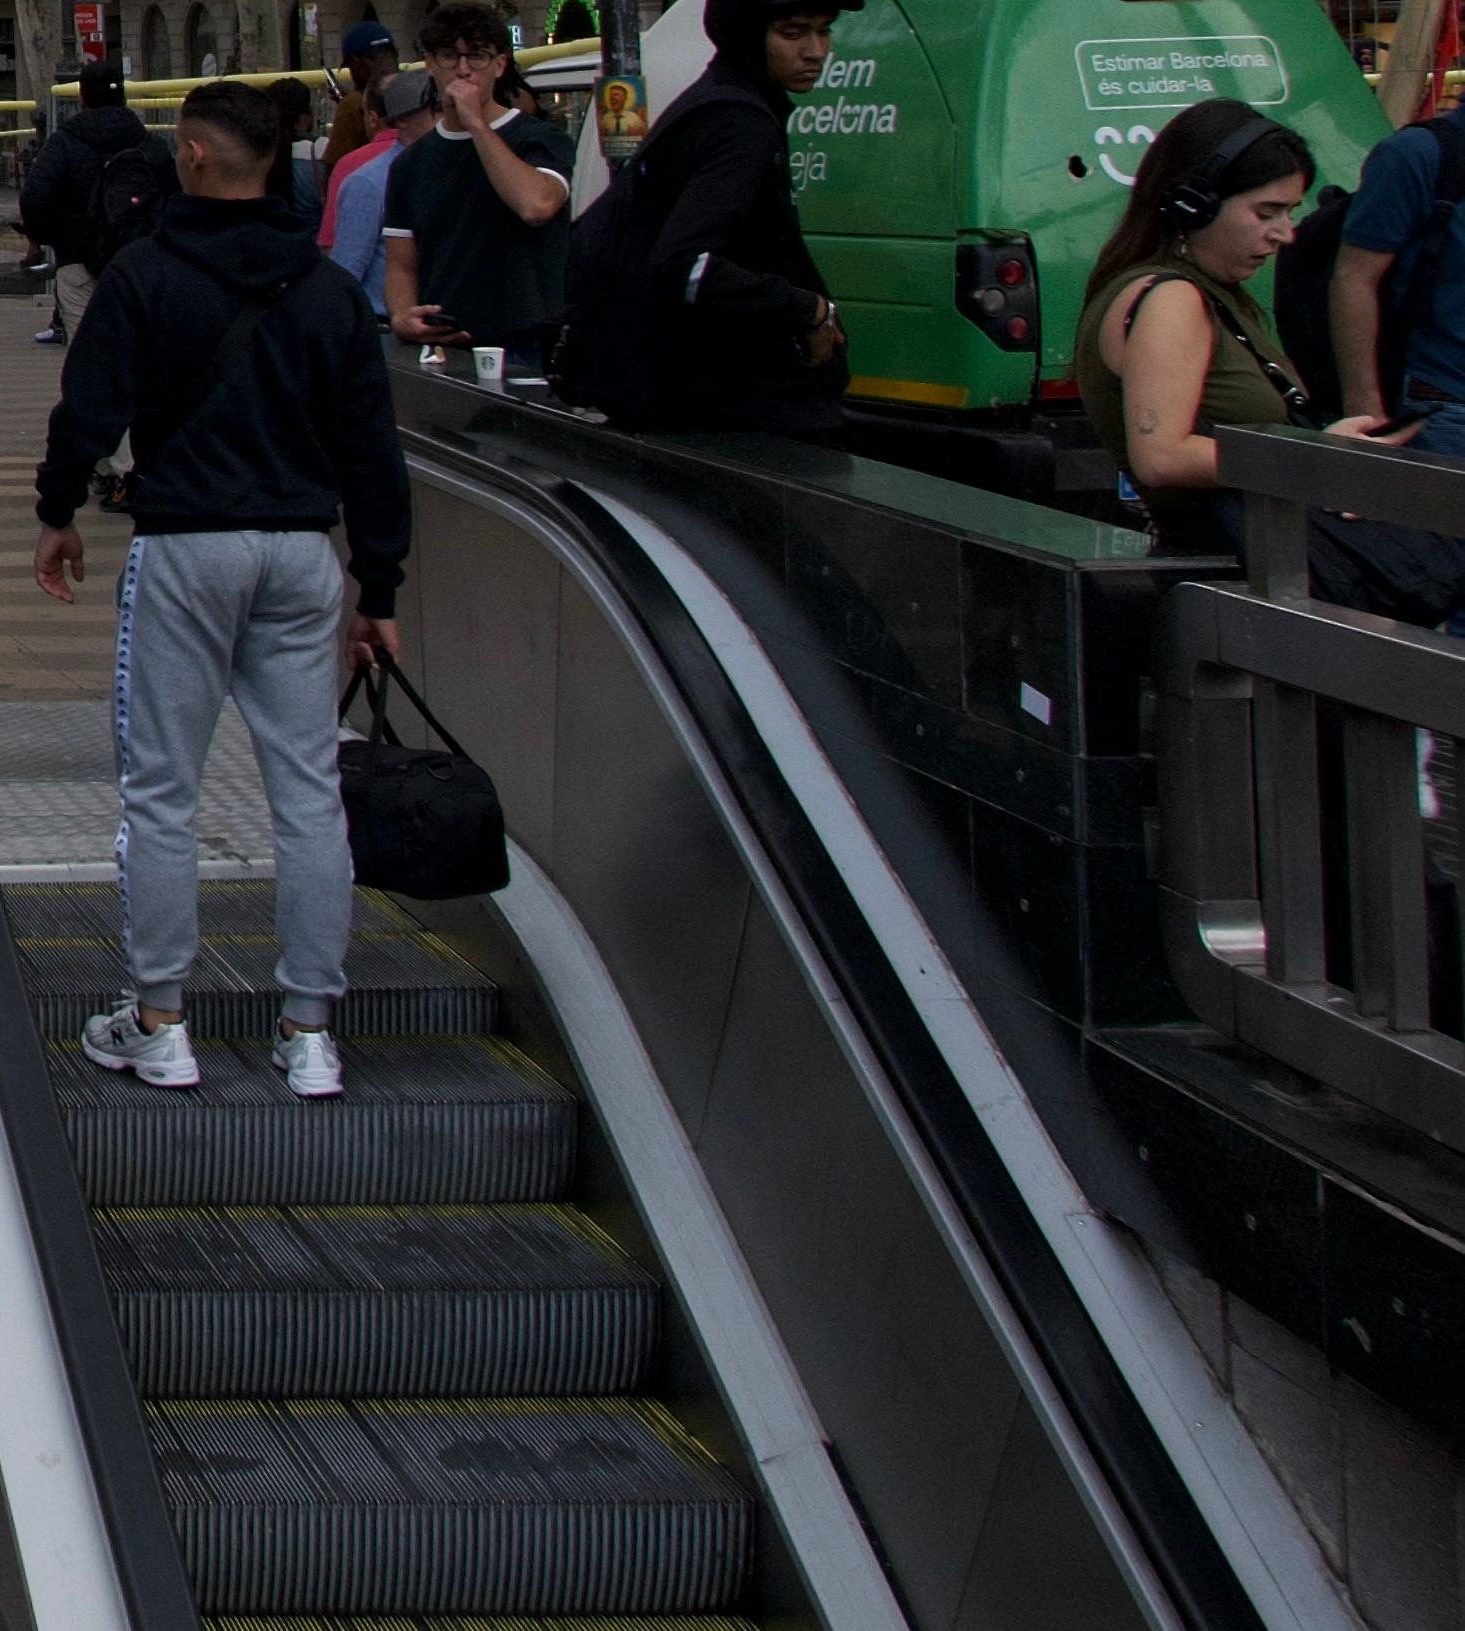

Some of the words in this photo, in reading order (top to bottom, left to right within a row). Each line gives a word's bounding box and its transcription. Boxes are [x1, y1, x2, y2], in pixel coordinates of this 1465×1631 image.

[1091, 54, 1167, 72] Estimar
[1170, 52, 1269, 69] Barcelona
[1098, 78, 1123, 95] és
[1128, 75, 1215, 95] cuidar-la
[786, 96, 897, 134] rcelona
[789, 142, 828, 191] eja
